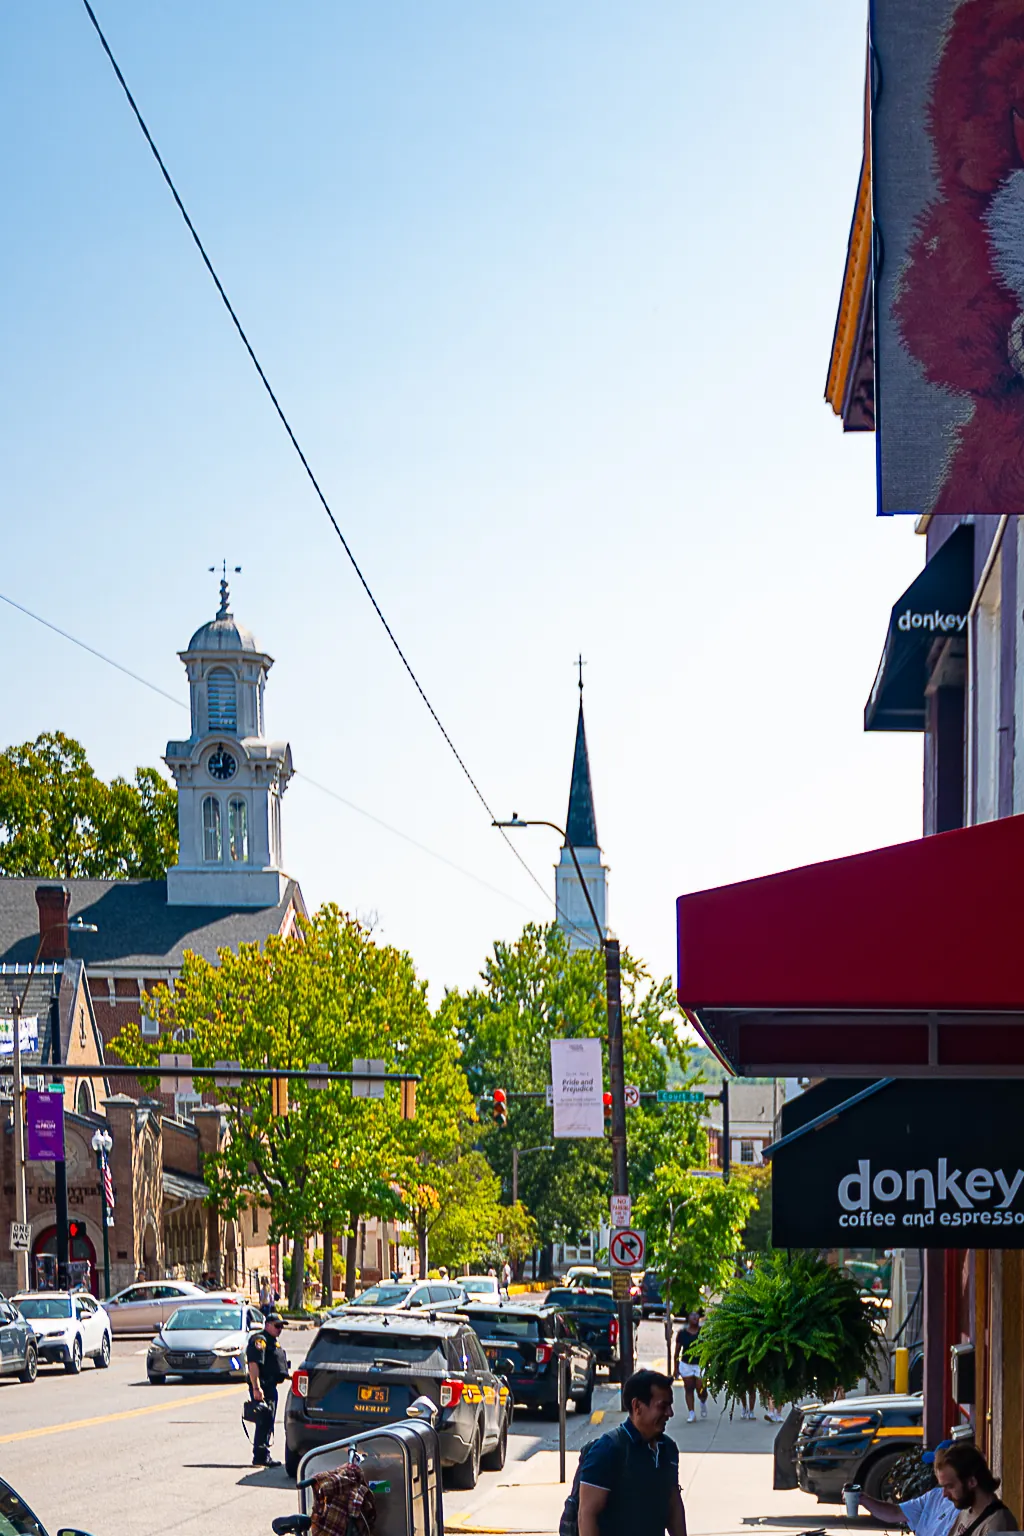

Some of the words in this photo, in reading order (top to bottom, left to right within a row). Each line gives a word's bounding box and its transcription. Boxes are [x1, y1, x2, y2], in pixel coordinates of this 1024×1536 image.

[898, 609, 967, 631] donkey
[562, 1078, 579, 1086] Pride
[580, 1078, 594, 1086] and
[562, 1085, 594, 1094] Prejudice
[838, 1211, 896, 1227] coffee
[902, 1210, 934, 1227] and
[939, 1210, 1024, 1227] espresso
[13, 1225, 29, 1233] ONE
[354, 1404, 390, 1413] SHERIFF
